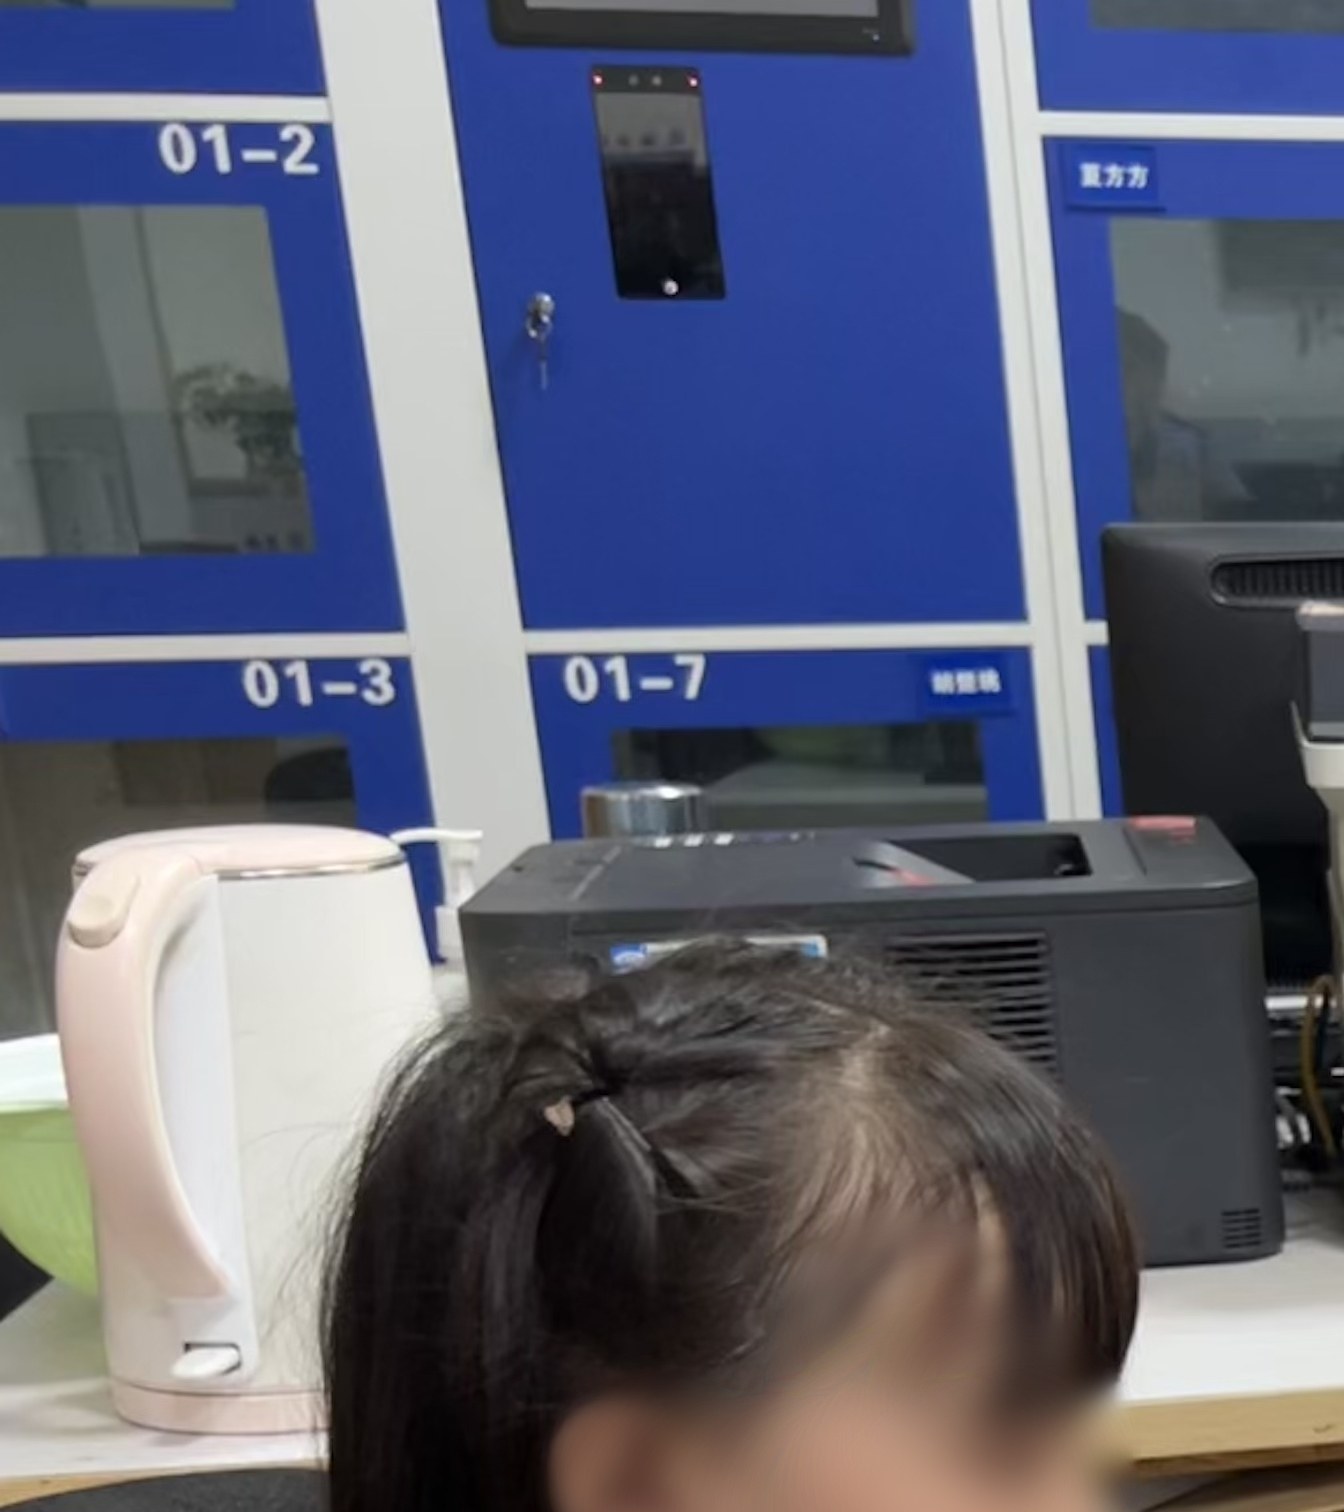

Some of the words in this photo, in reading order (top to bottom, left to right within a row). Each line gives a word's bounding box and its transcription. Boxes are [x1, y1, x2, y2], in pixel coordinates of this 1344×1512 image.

[158, 122, 320, 175] 01-2
[243, 657, 397, 708] 01-3
[563, 653, 707, 704] 01-7
